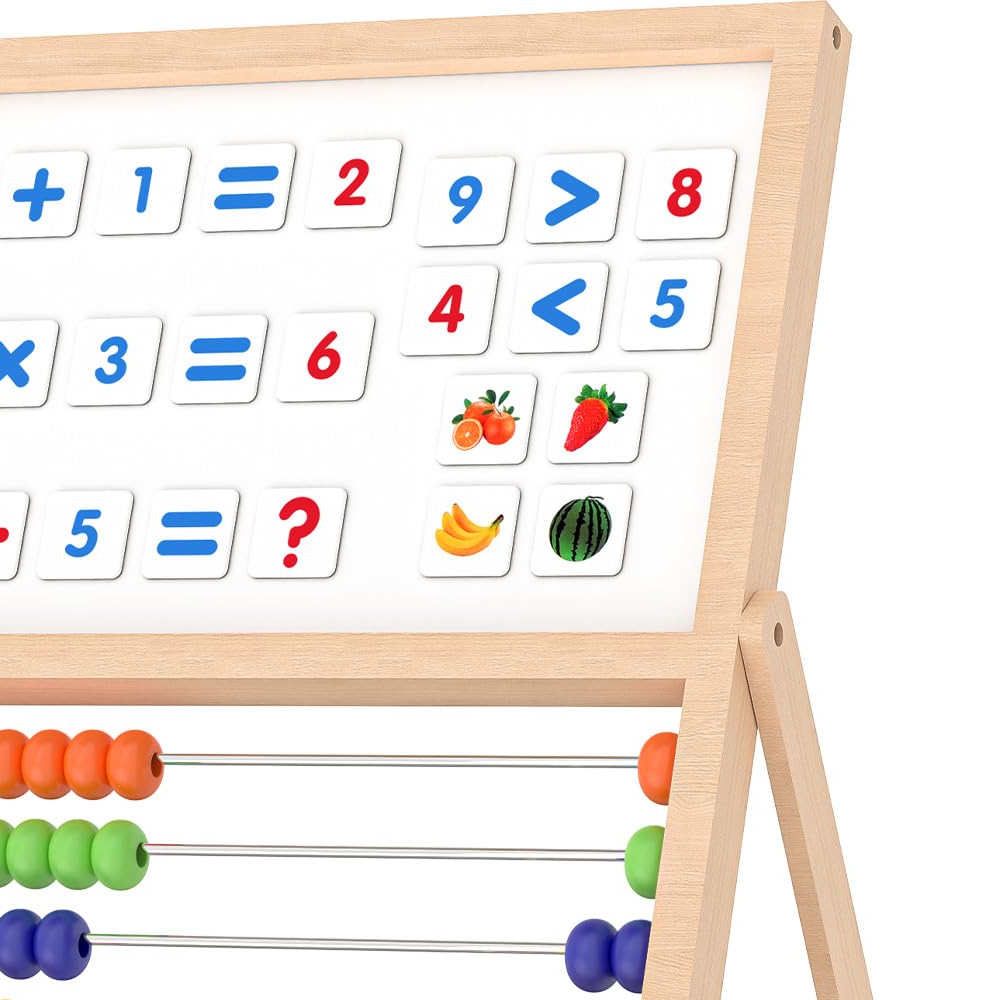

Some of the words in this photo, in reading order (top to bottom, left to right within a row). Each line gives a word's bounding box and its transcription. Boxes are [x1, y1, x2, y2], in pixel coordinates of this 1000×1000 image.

[13, 168, 65, 221] +
[135, 167, 152, 213] 1
[214, 166, 278, 210] =
[334, 159, 369, 206] 2
[449, 176, 482, 224] 9
[545, 170, 600, 226] >
[667, 168, 702, 217] 8
[428, 284, 464, 333] 4
[532, 279, 586, 335] <
[650, 279, 687, 328] 5
[95, 336, 128, 384] 3
[186, 337, 251, 381] =
[307, 331, 341, 380] 6
[65, 509, 101, 557] 5
[157, 512, 222, 556] =
[279, 497, 320, 568] ?
